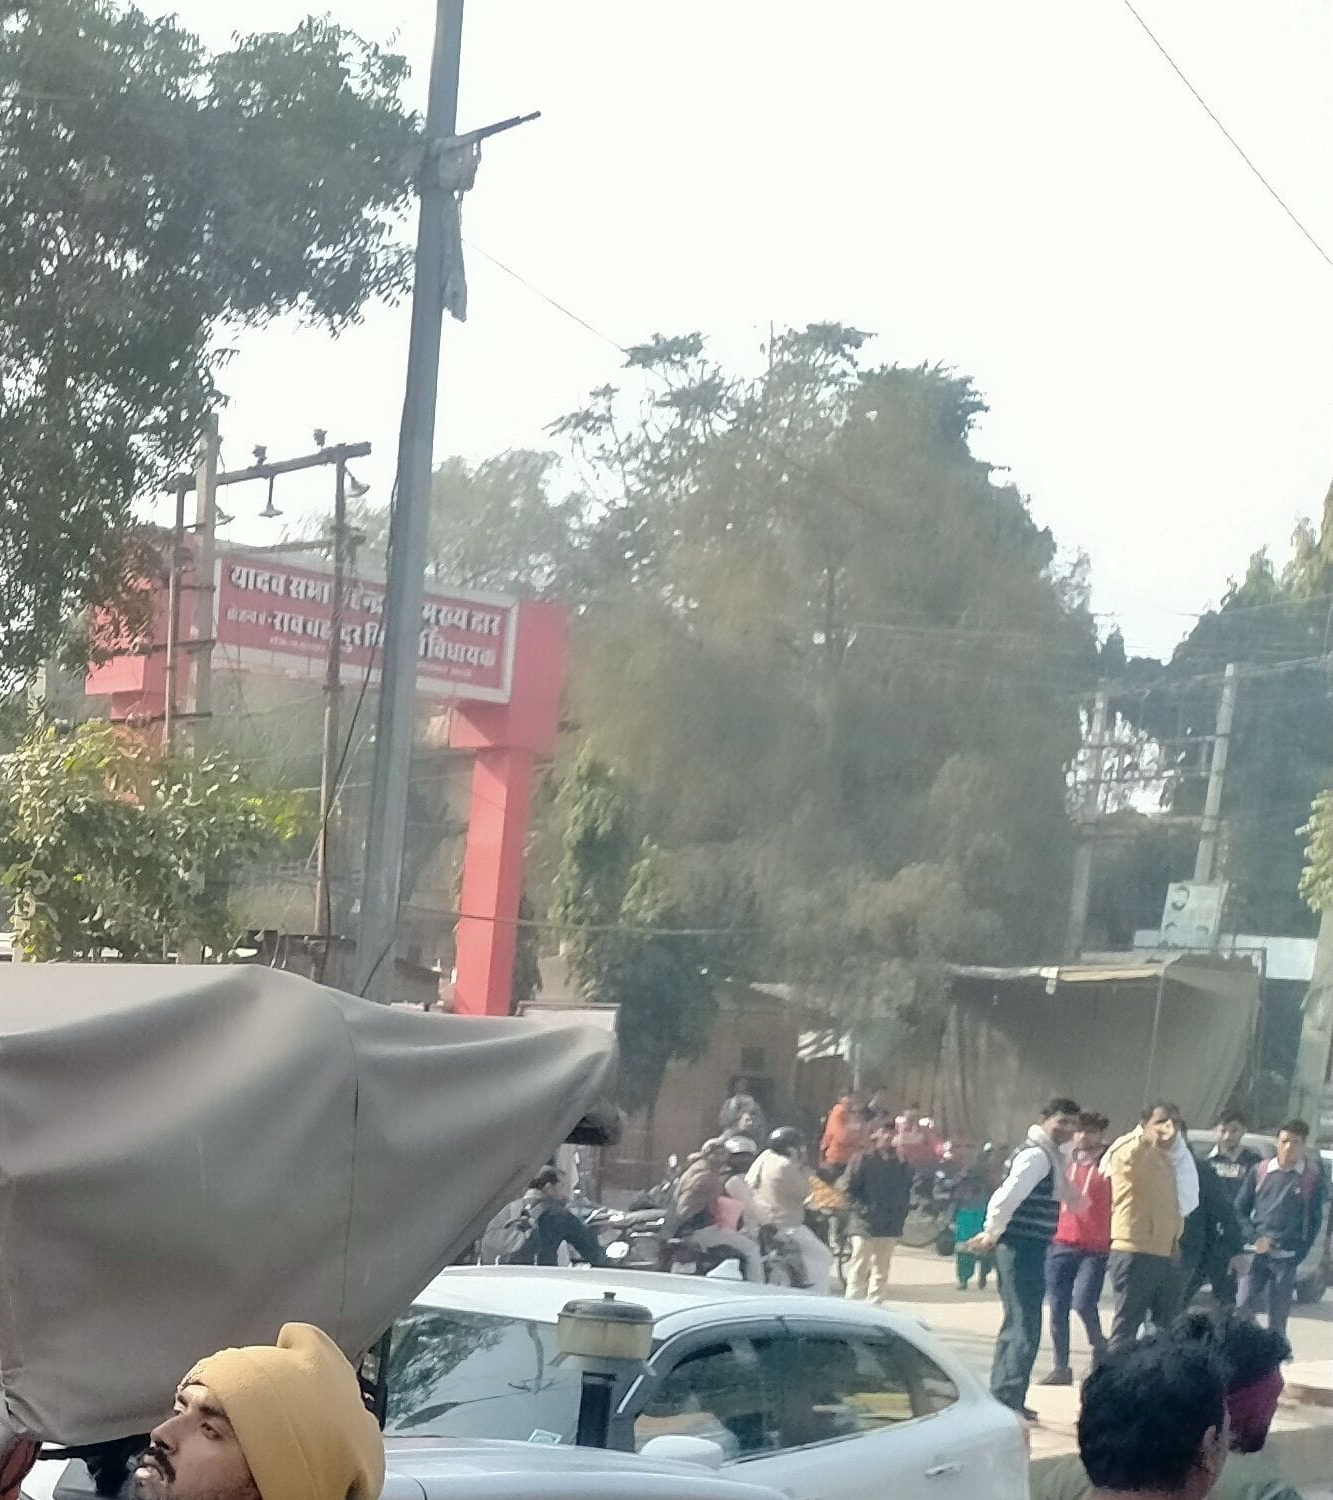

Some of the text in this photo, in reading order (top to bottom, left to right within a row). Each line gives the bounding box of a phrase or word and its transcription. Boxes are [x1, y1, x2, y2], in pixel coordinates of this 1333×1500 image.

[230, 564, 286, 597] यादव
[289, 574, 331, 605] सभा
[273, 609, 304, 635] राव
